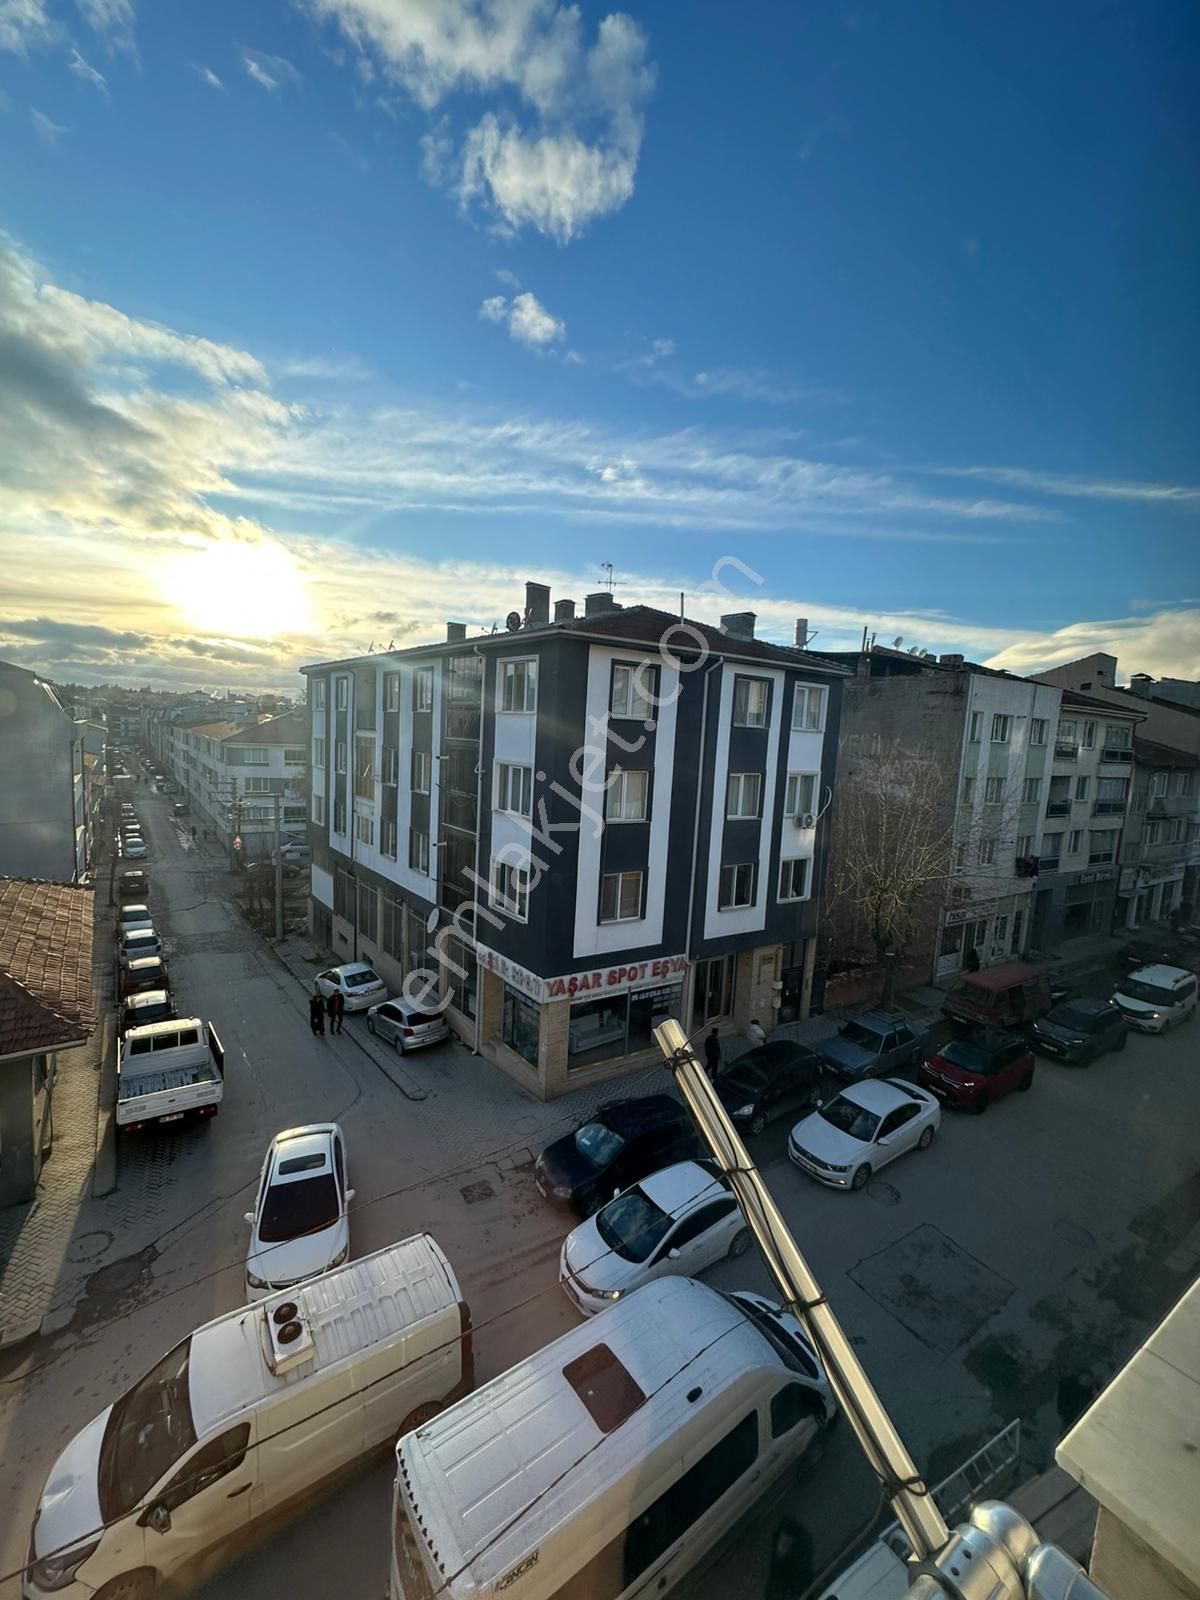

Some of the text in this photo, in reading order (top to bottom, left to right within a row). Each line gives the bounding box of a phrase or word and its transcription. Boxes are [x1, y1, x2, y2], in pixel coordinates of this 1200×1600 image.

[546, 972, 602, 998] YAŞAR
[607, 963, 649, 986] SPOT
[652, 956, 688, 979] EŞYA
